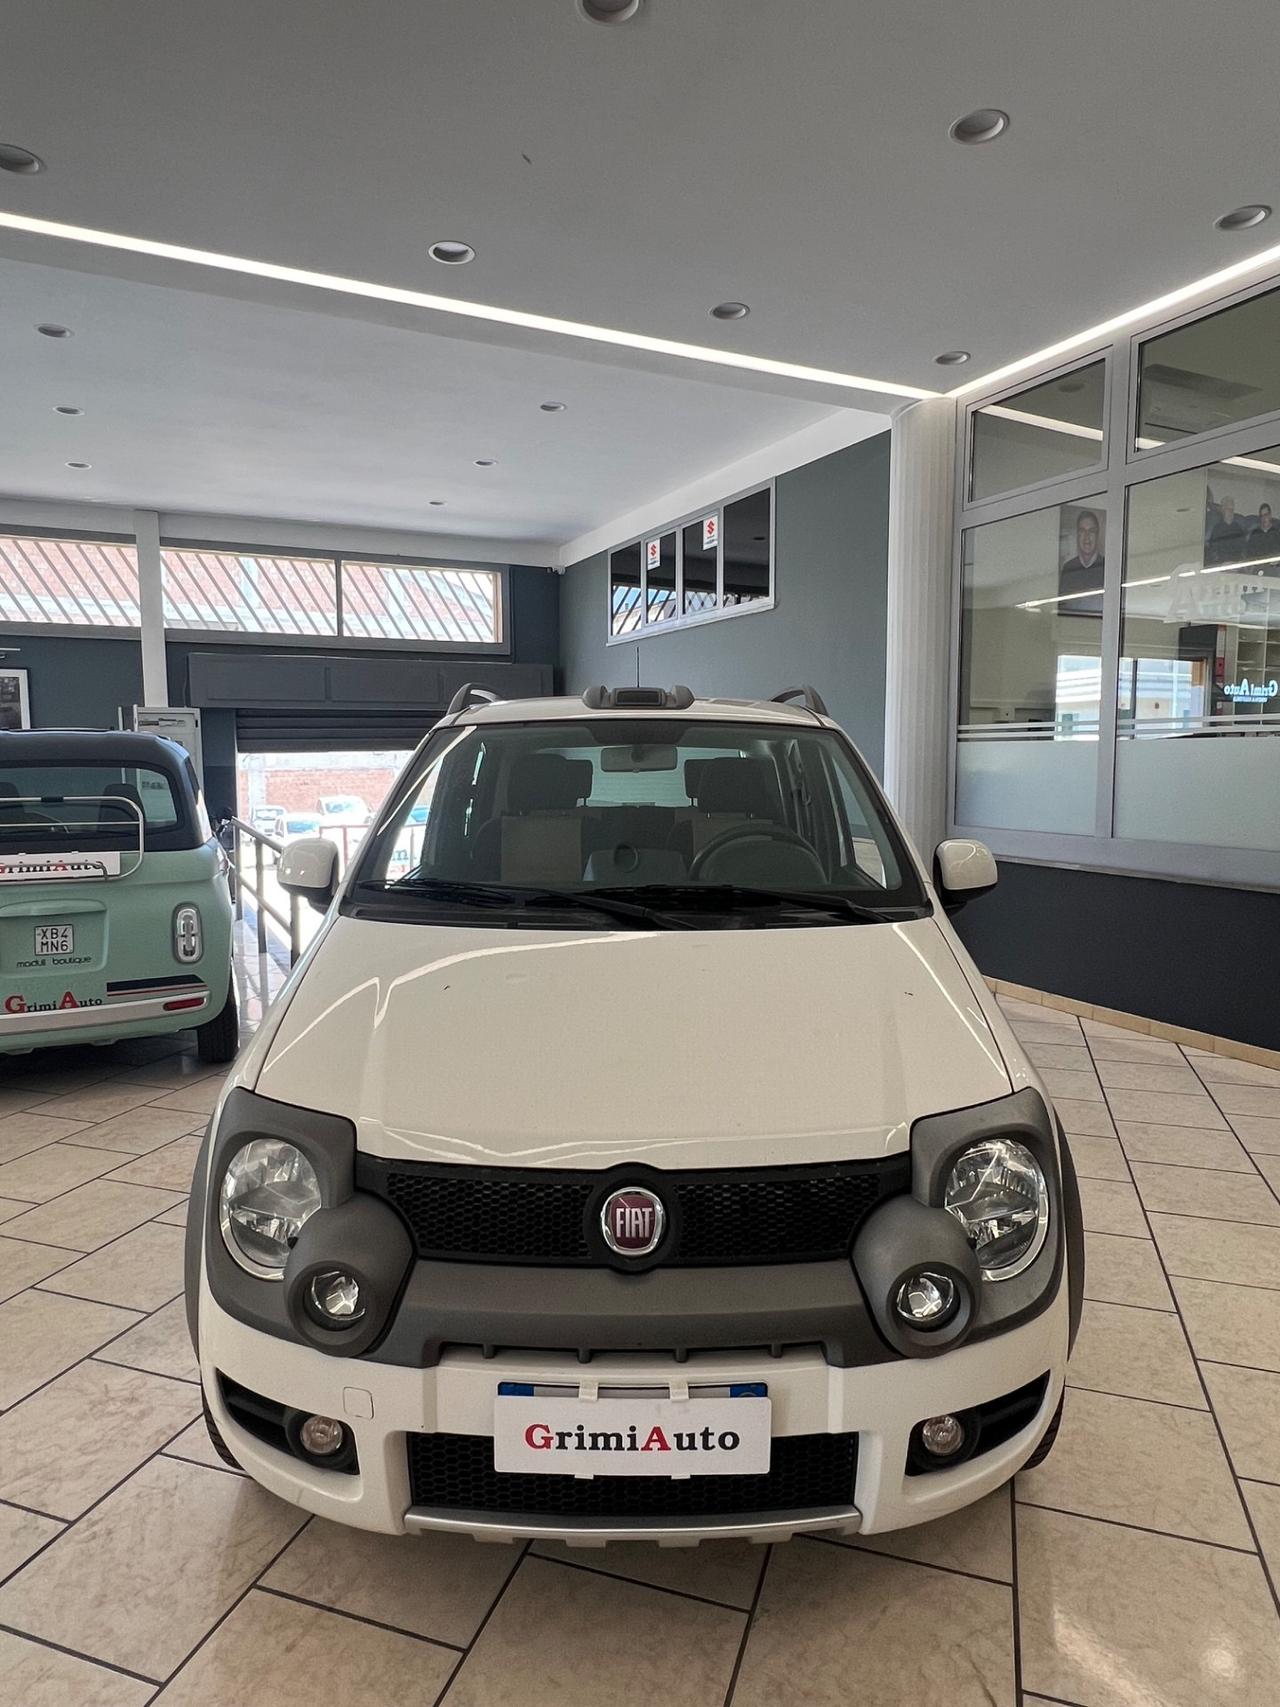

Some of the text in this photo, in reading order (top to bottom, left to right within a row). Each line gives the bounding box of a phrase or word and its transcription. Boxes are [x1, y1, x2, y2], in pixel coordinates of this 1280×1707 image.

[40, 927, 69, 940] XB4
[40, 940, 69, 952] MN6
[4, 991, 103, 1013] GrimiAuto
[615, 1207, 652, 1238] FIAT
[524, 1422, 740, 1452] GrimiAuto
